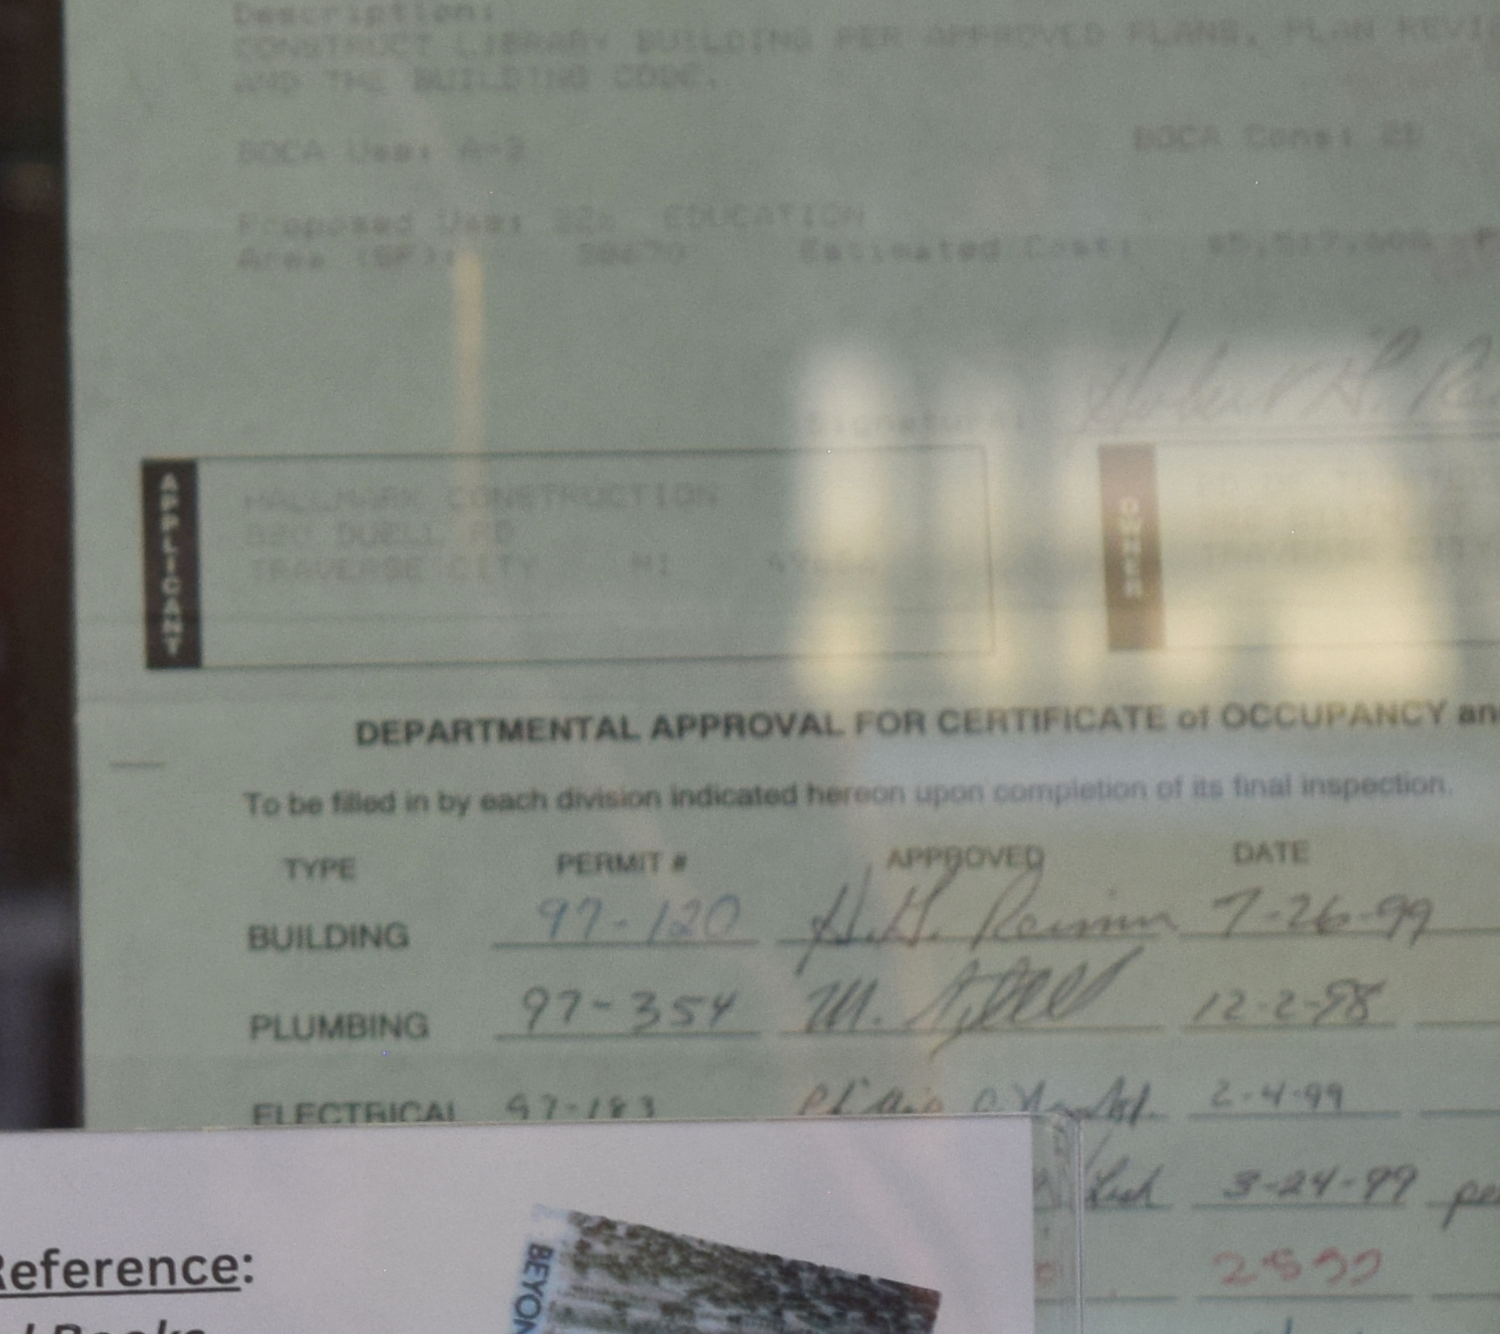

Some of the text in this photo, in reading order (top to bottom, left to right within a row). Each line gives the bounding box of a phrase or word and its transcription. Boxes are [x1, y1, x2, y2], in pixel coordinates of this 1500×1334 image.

[354, 699, 1447, 748] DEPARTMENTAL APPROVAL FOR CERTIFICATE of OCCUPANCY
[244, 791, 281, 817] To
[288, 789, 324, 816] be
[330, 789, 397, 816] filled
[405, 788, 431, 814] in
[437, 788, 471, 819] by
[479, 787, 549, 814] each
[555, 785, 663, 812] division
[669, 782, 799, 811] indicated
[805, 781, 906, 808] hereon
[914, 780, 986, 808] upon
[993, 777, 1148, 808] completion
[1155, 775, 1185, 801] of
[1192, 775, 1225, 800] its
[1233, 773, 1293, 799] final
[283, 851, 663, 881] TYPE PERMIT
[887, 840, 1311, 870] APPROVED DATE
[246, 922, 411, 952] BUILDING
[248, 1011, 431, 1043] PLUMBING
